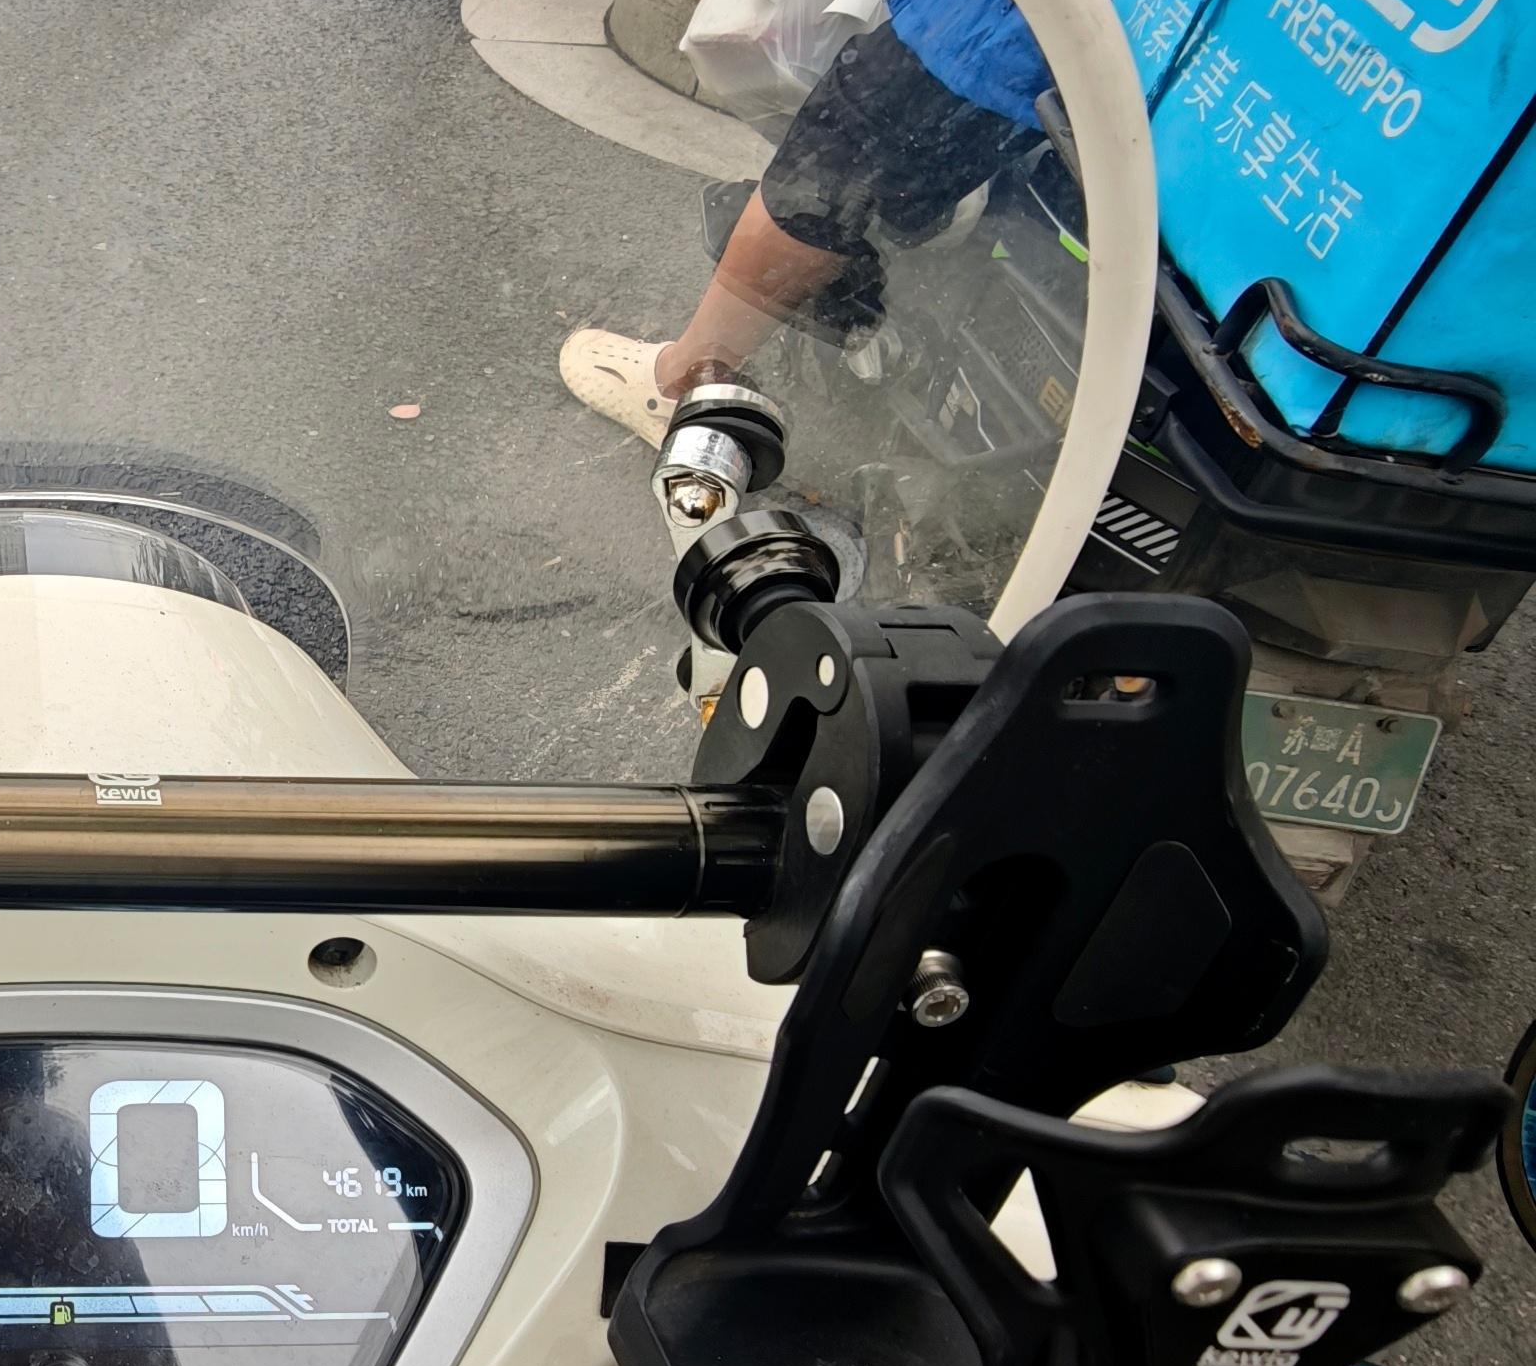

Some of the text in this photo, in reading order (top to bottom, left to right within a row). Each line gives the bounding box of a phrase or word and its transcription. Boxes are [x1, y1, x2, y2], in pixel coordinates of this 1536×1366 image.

[90, 1081, 227, 1238] 0
[406, 1183, 428, 1197] km
[231, 1222, 269, 1237] km/h
[327, 1218, 378, 1234] TOTAL
